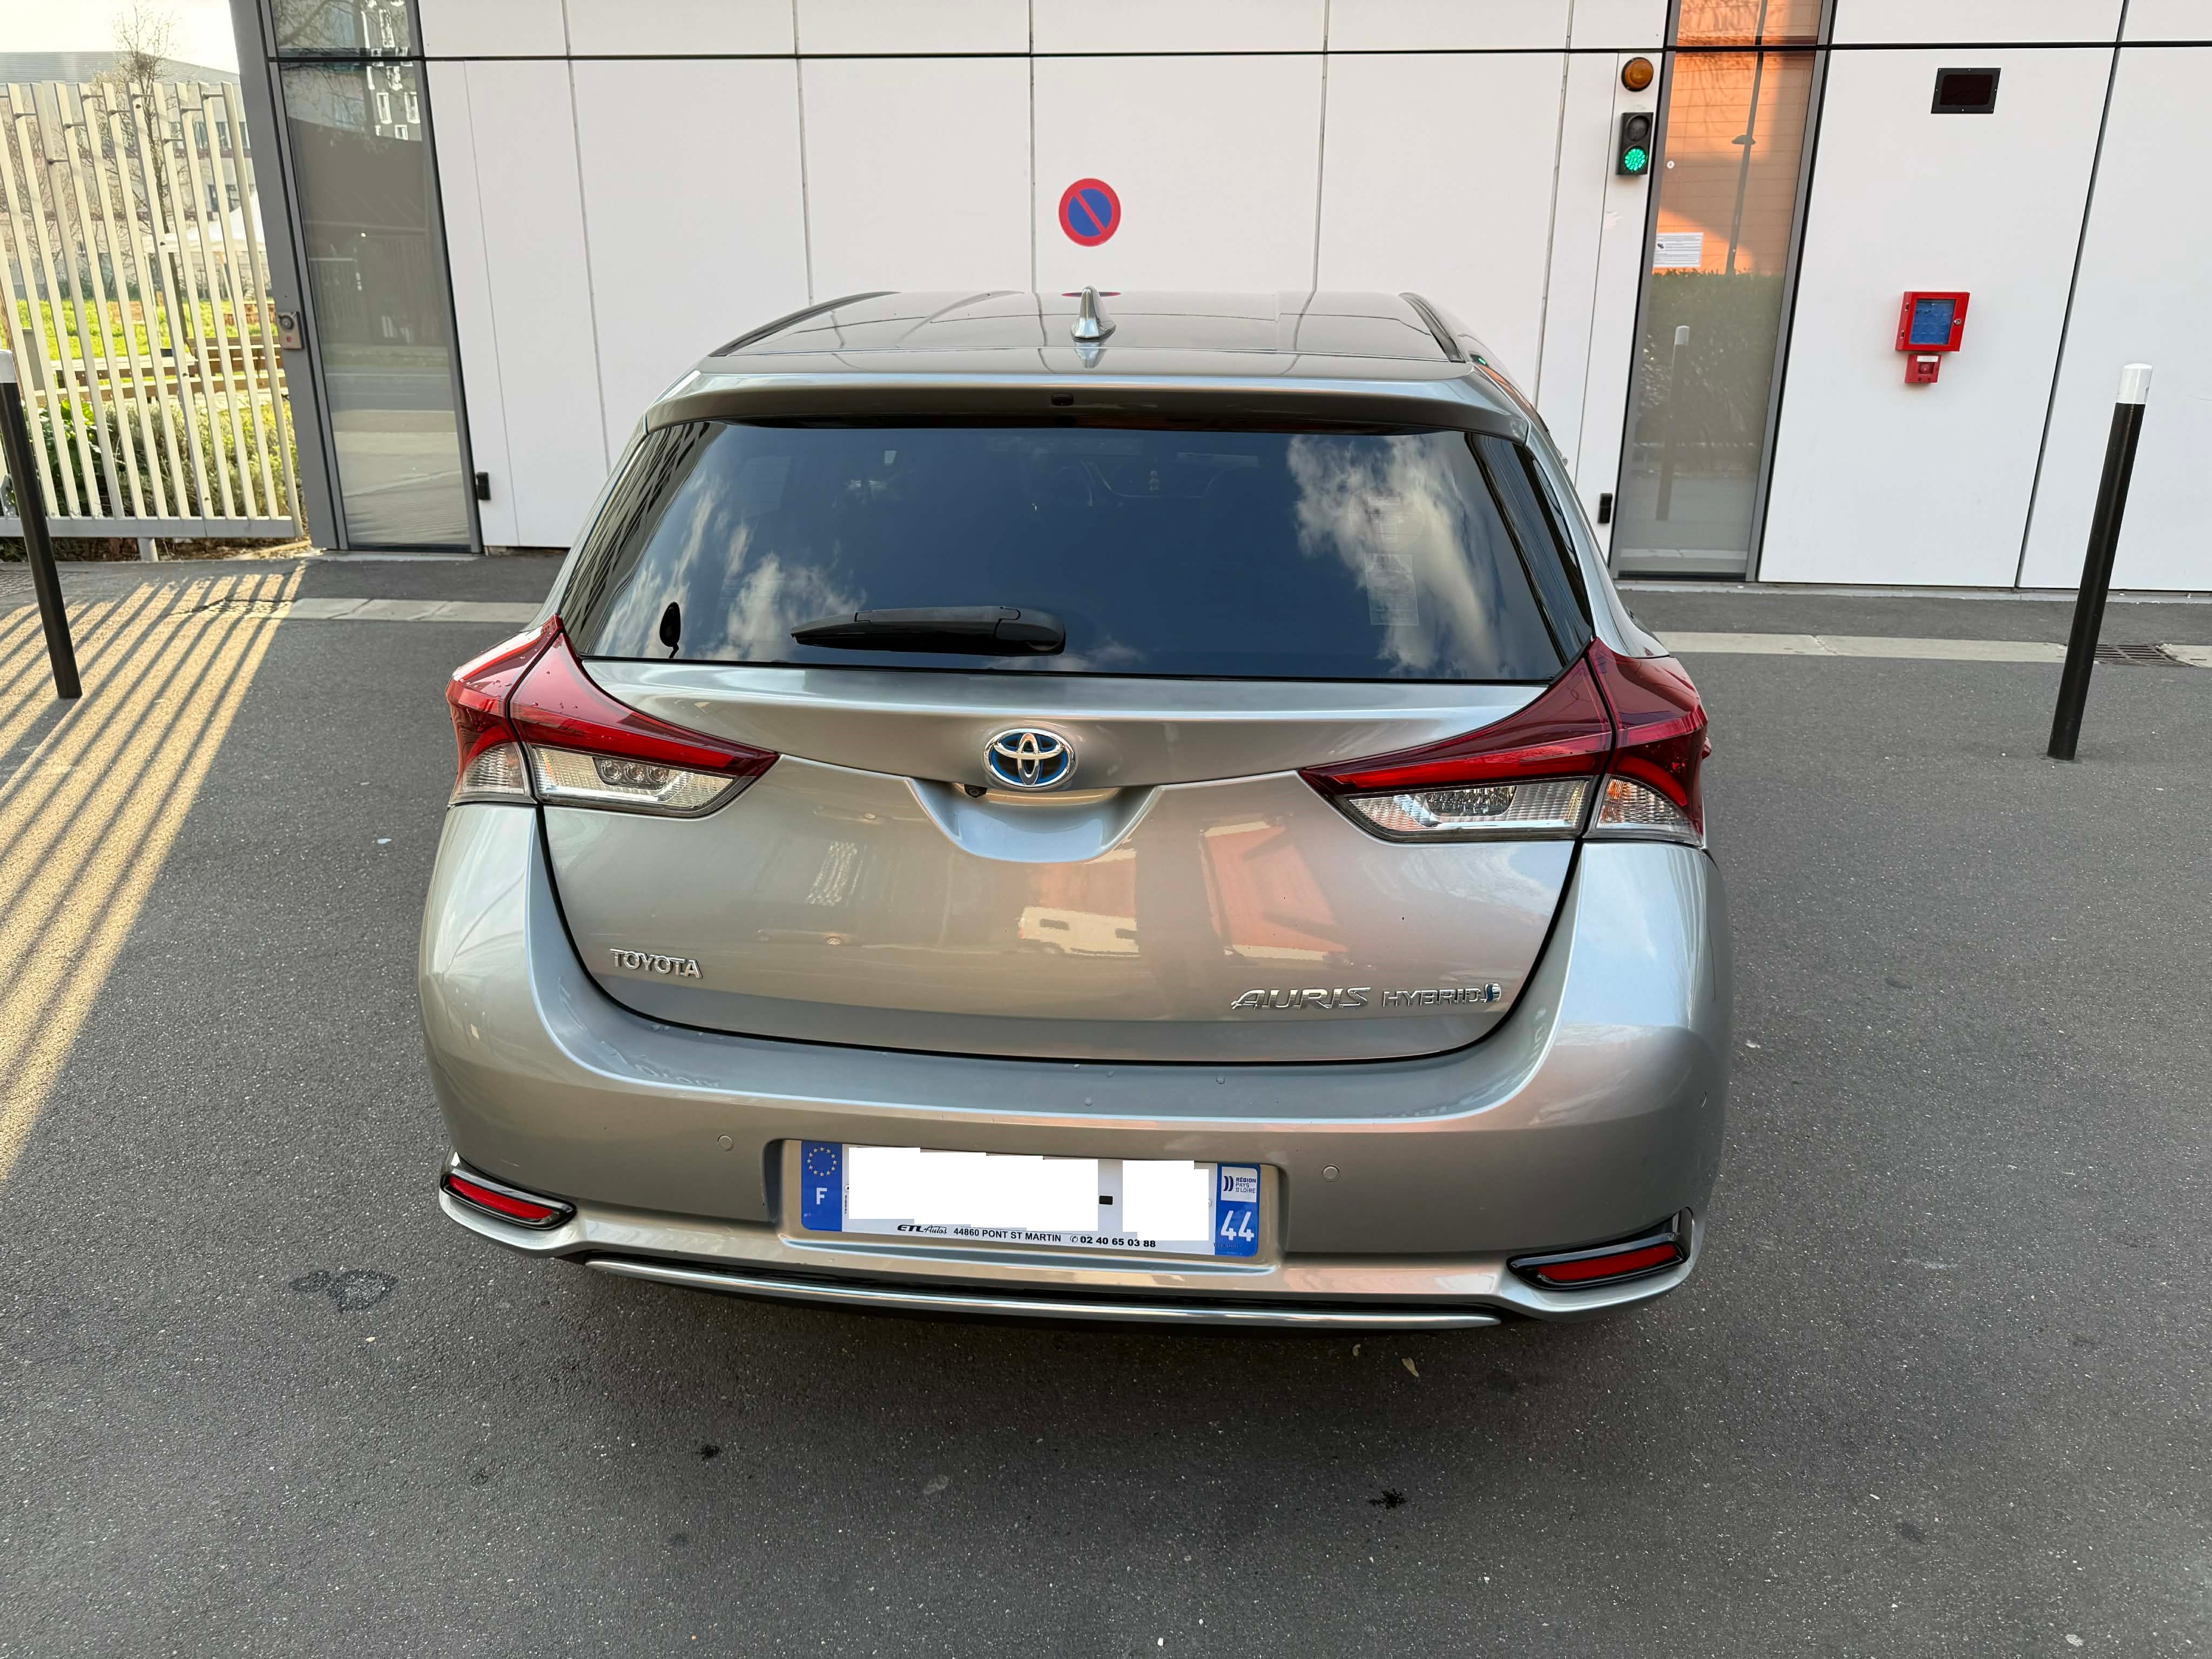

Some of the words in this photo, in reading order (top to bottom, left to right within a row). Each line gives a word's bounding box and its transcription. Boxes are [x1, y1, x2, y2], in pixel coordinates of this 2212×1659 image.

[610, 948, 703, 979] TOYOTA
[1231, 986, 1371, 1010] AURIS
[1383, 988, 1481, 1007] HYBRID
[816, 1187, 828, 1205] F
[954, 1227, 980, 1236] 44860
[982, 1230, 1009, 1239] PONT
[1026, 1233, 1061, 1242] MARTIN
[1220, 1210, 1255, 1242] 44
